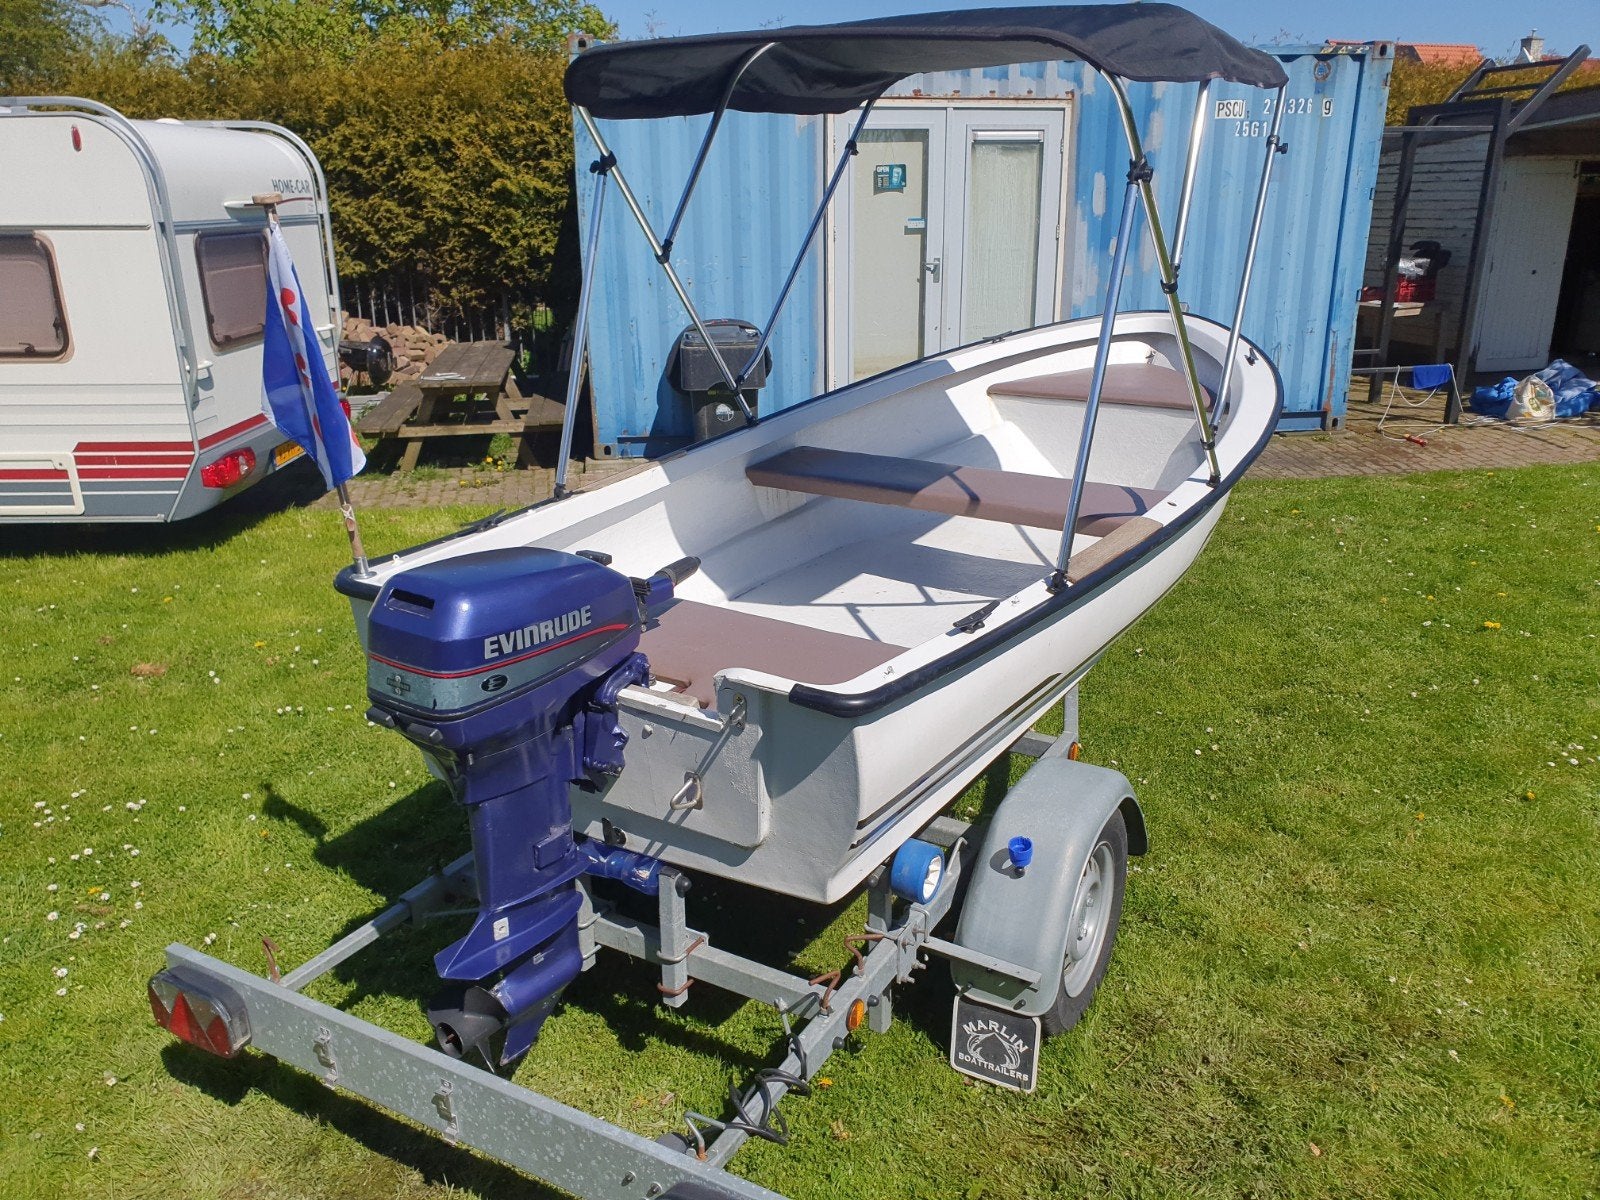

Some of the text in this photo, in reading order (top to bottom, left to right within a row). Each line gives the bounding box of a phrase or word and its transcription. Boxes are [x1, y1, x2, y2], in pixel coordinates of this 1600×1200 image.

[1217, 101, 1245, 117] PSCU
[1323, 100, 1332, 116] 9
[1235, 121, 1269, 137] 25G1
[271, 179, 310, 193] HOME-CAR
[484, 605, 591, 659] EVINRUDE
[962, 1019, 1029, 1053] MARLIN
[958, 1052, 1029, 1081] BOATTRAILERS
